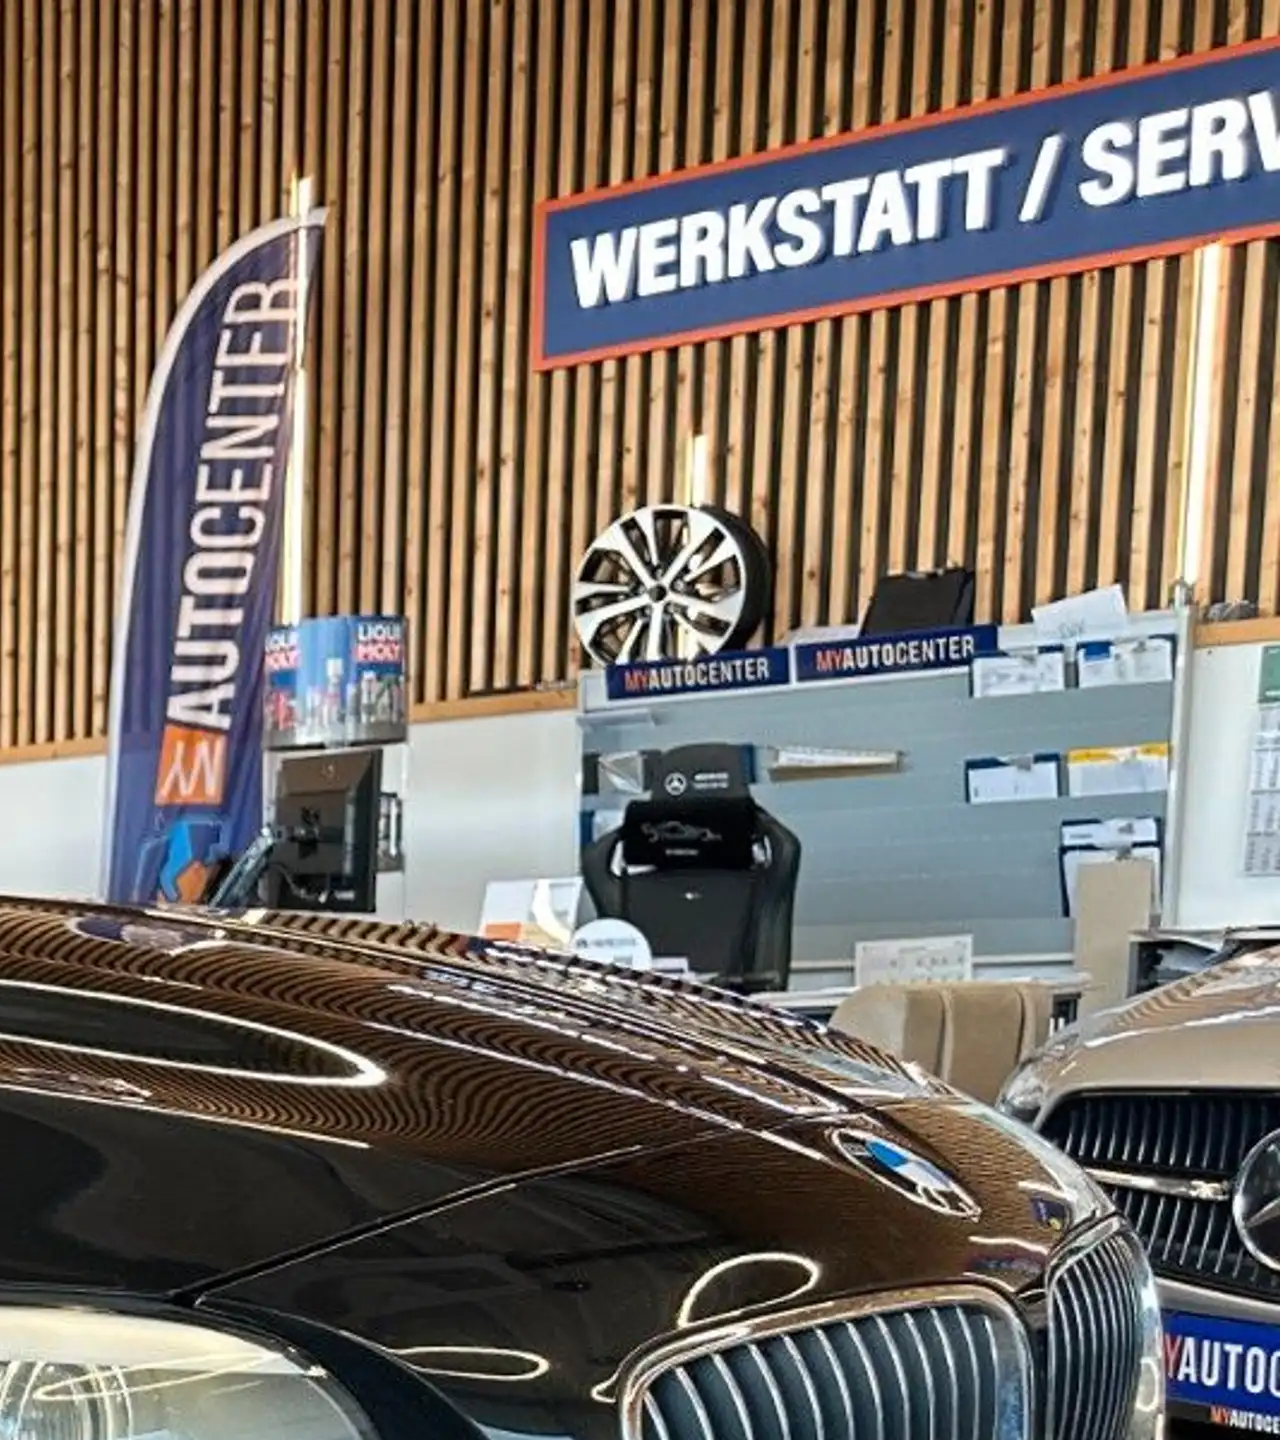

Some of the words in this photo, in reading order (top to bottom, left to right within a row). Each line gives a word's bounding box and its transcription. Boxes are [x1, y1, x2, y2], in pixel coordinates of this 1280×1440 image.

[570, 148, 1006, 309] WERKSTATT
[1020, 136, 1060, 223] /
[816, 635, 975, 673] MYAUTOCENTER
[624, 656, 770, 693] MYAUTOCENTER
